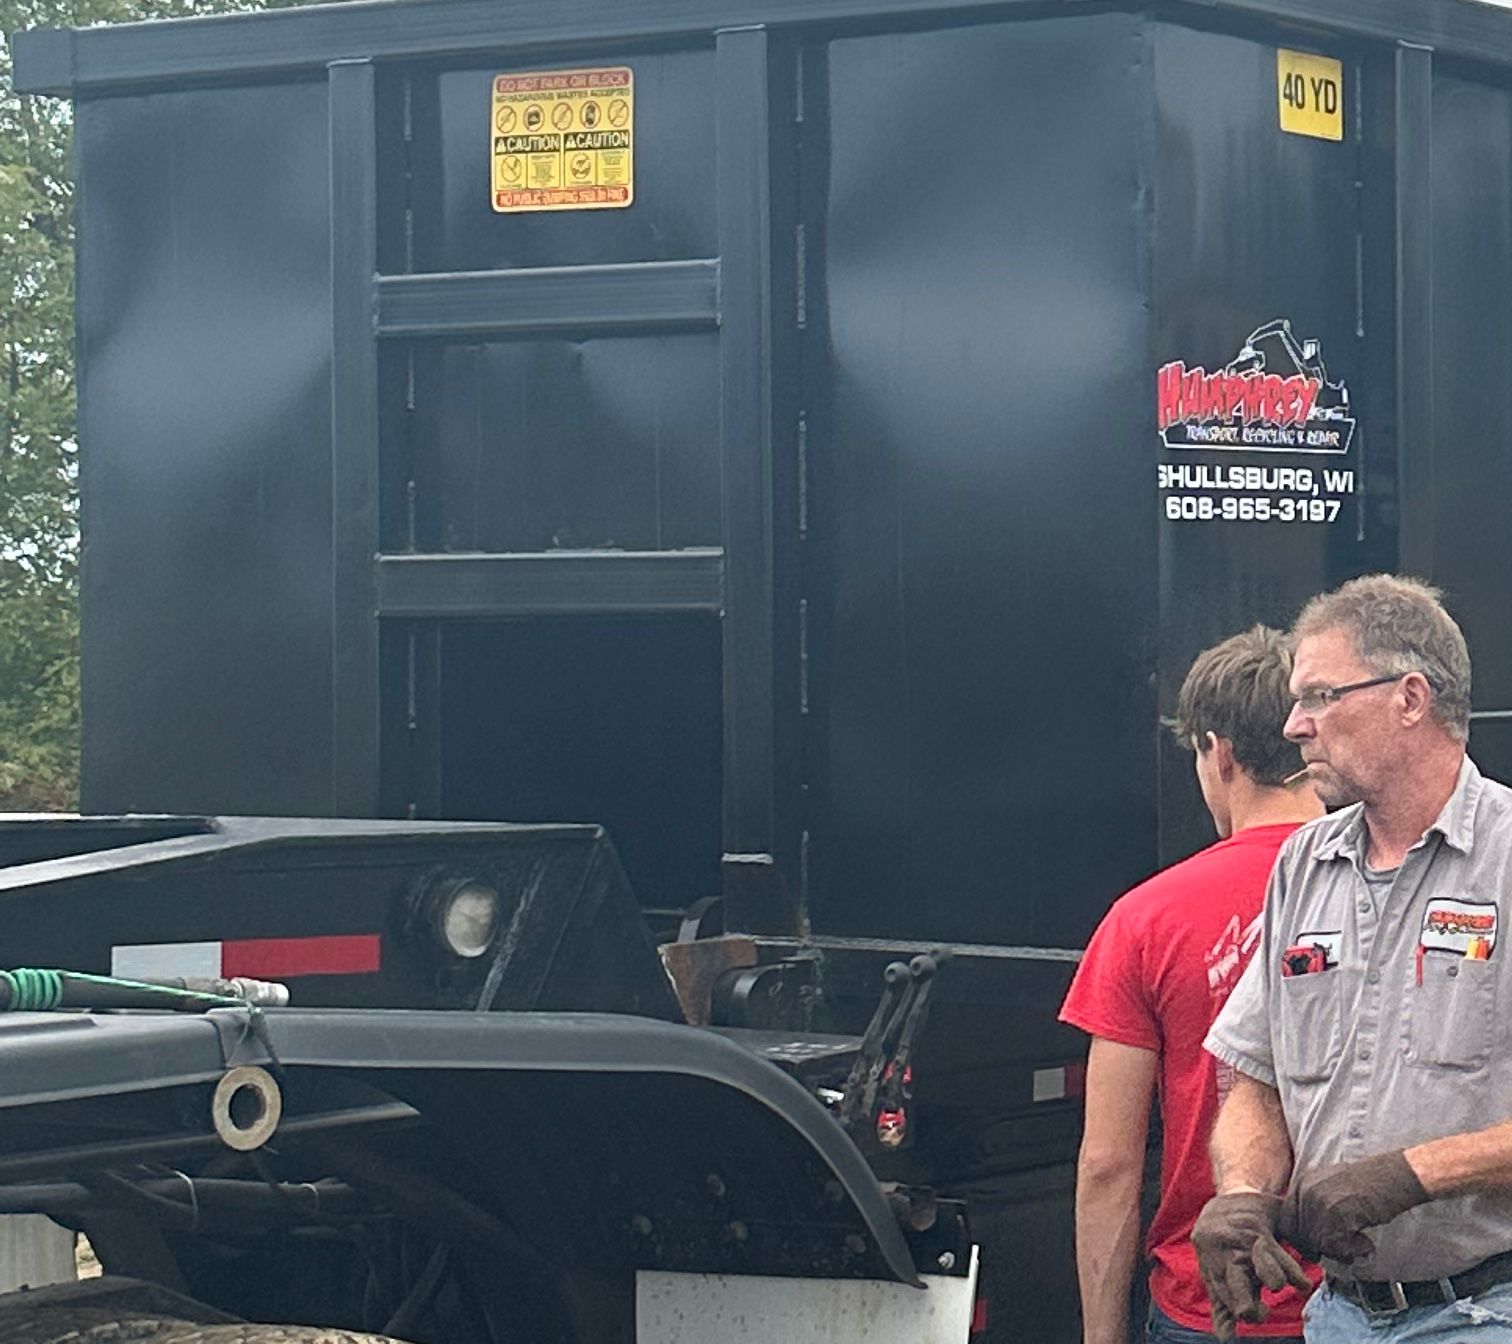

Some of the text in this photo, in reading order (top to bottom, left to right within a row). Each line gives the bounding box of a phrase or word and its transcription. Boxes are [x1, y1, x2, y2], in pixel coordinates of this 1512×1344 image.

[1283, 72, 1337, 115] 40 YD
[507, 136, 560, 152] CAUTION
[575, 132, 629, 149] CAUTION
[1158, 362, 1320, 430] HUMPHREY
[1323, 469, 1355, 493] WI
[1166, 496, 1341, 522] 608-965-3197
